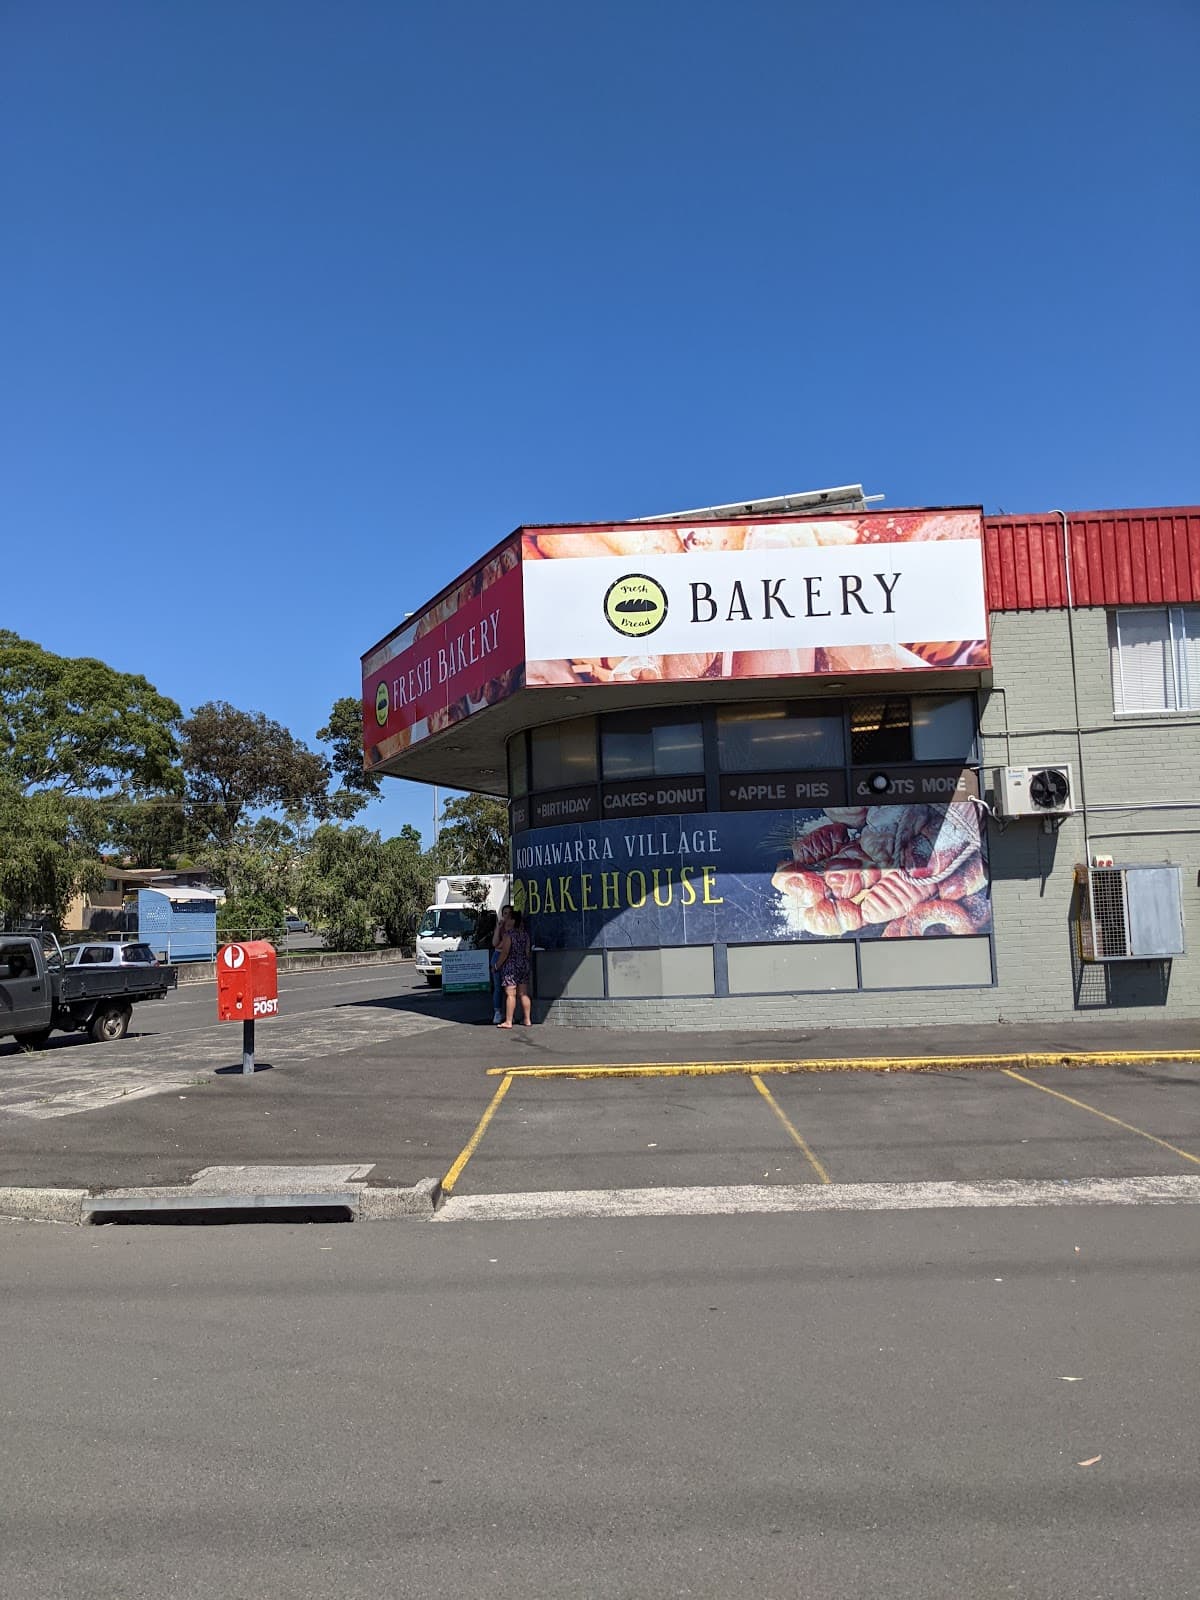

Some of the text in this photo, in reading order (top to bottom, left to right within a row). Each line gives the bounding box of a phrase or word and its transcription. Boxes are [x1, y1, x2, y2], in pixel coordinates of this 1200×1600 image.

[620, 584, 648, 595] Fresh
[688, 572, 903, 623] BAKERY
[621, 616, 651, 628] Bread
[392, 608, 500, 712] FRESH BAKERY
[796, 782, 829, 798] PIES
[856, 781, 871, 796] &
[922, 777, 967, 793] MORE
[516, 829, 721, 870] KOONAWARRA VILLAGE
[527, 865, 724, 915] BAKEHOUSE
[253, 998, 278, 1016] POST
